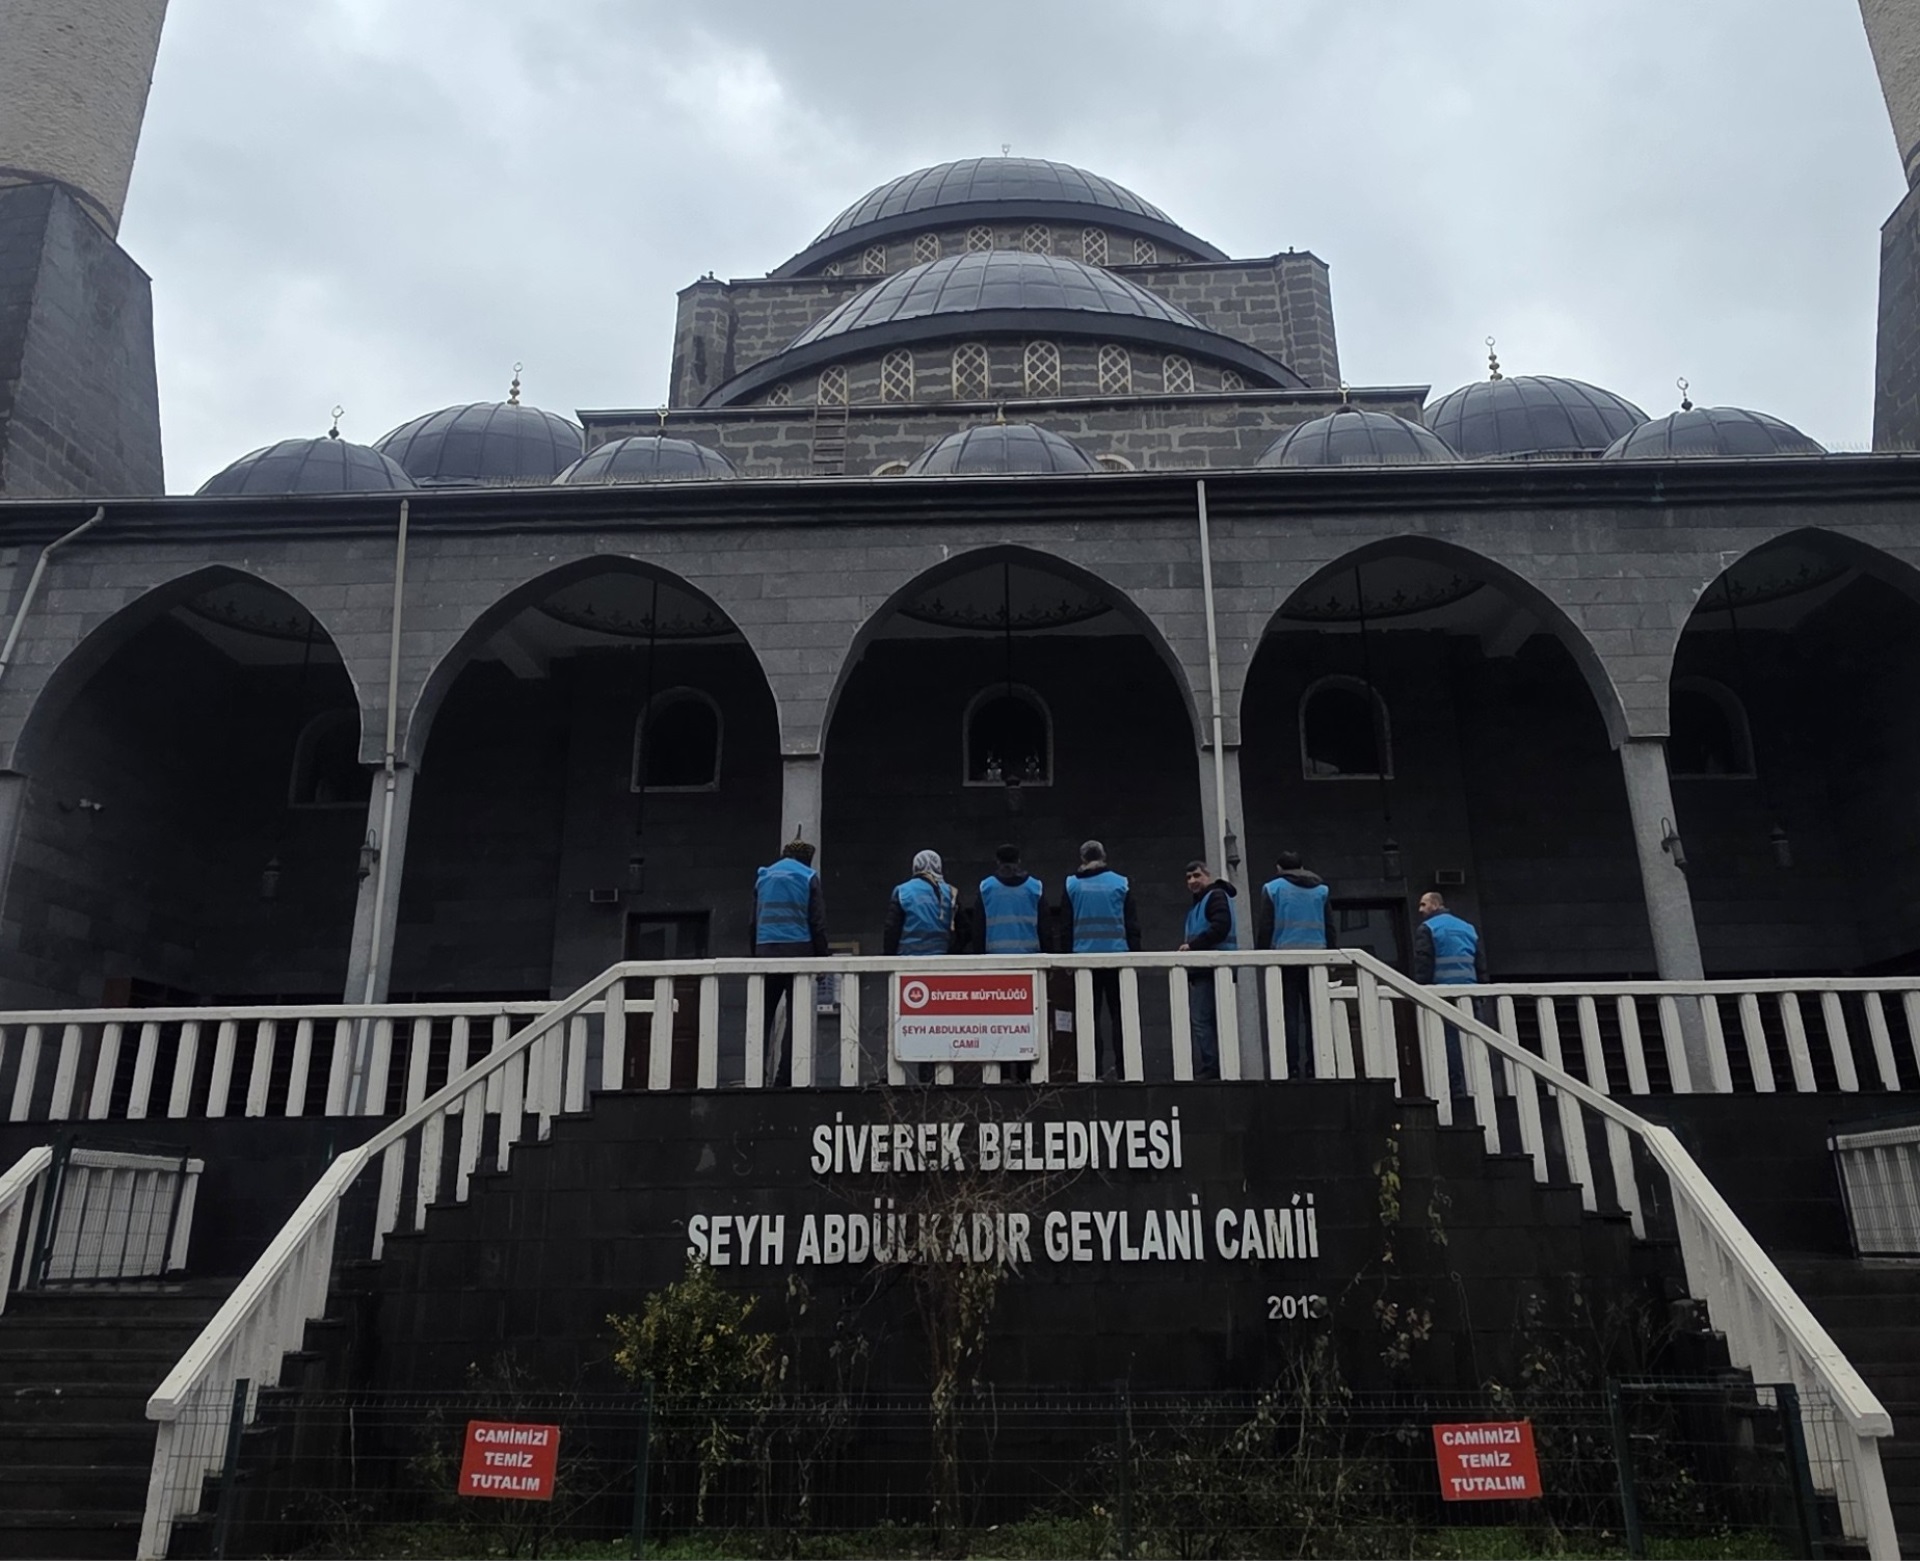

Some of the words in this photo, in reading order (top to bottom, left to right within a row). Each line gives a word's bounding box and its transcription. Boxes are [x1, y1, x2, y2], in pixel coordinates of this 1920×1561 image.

[931, 989, 969, 1001] SİVEREK
[971, 988, 1027, 1000] MÜFTÜLÜĞÜ
[902, 1025, 926, 1037] ŞEYH
[929, 1023, 988, 1035] ABDULKADİR
[990, 1022, 1031, 1035] GEYLANİ
[811, 1111, 965, 1174] SİVEREK
[979, 1106, 1183, 1171] BELEDIYESİ
[1044, 1194, 1204, 1263] GEYLANİ
[474, 1428, 549, 1446] CAMİMİZİ
[1442, 1427, 1521, 1446] CAMİMİZİ
[484, 1451, 534, 1468] TEMİZ
[1458, 1450, 1512, 1469] TEMİZ
[471, 1474, 540, 1491] TUTALIM
[1450, 1475, 1526, 1493] TUTALIM
